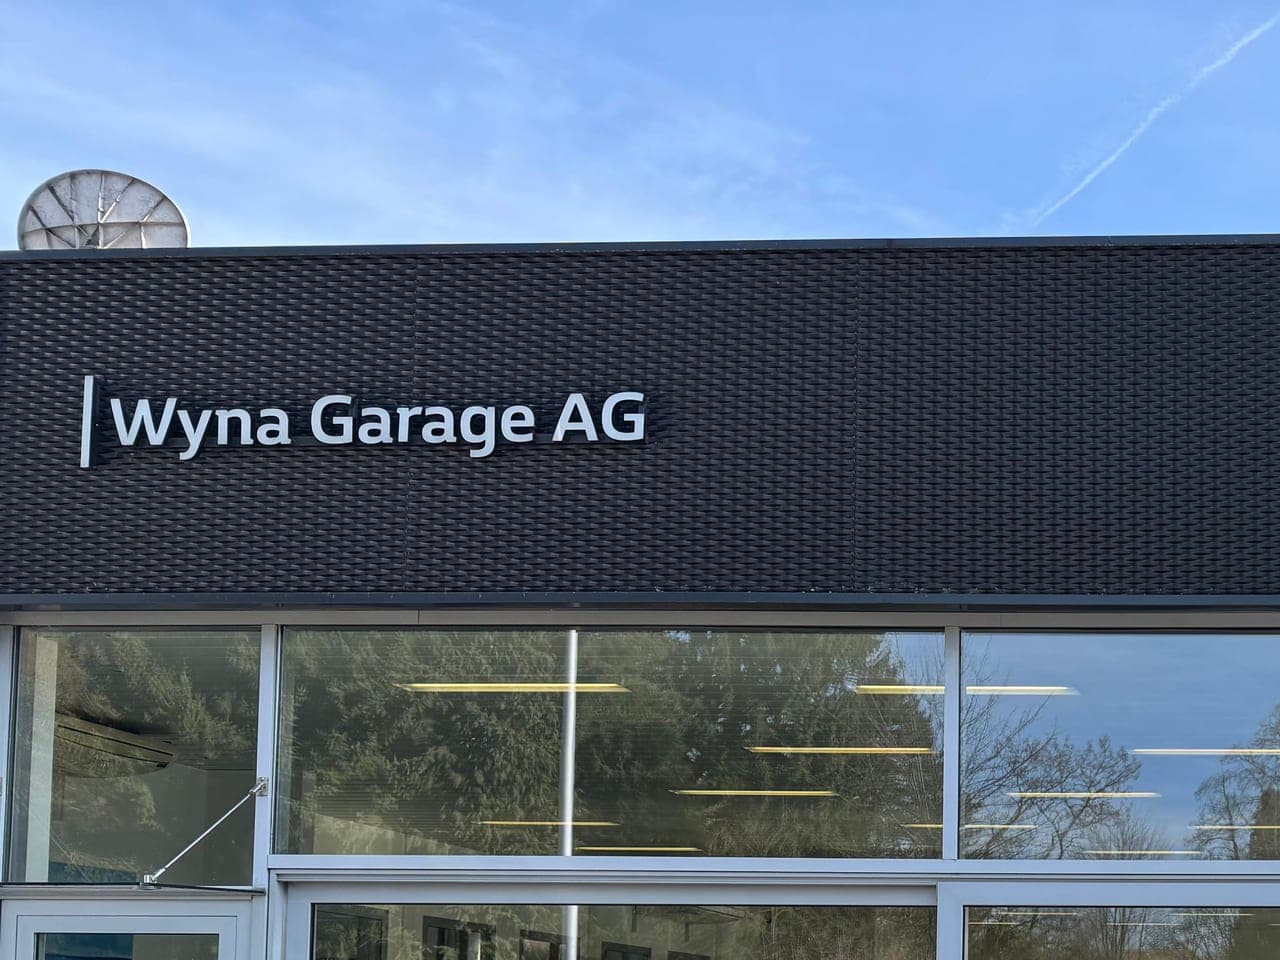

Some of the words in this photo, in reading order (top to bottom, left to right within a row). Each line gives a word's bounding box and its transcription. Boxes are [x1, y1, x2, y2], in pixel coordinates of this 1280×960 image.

[111, 398, 291, 460] Wyna
[311, 395, 534, 457] Garage
[552, 392, 644, 441] AG
